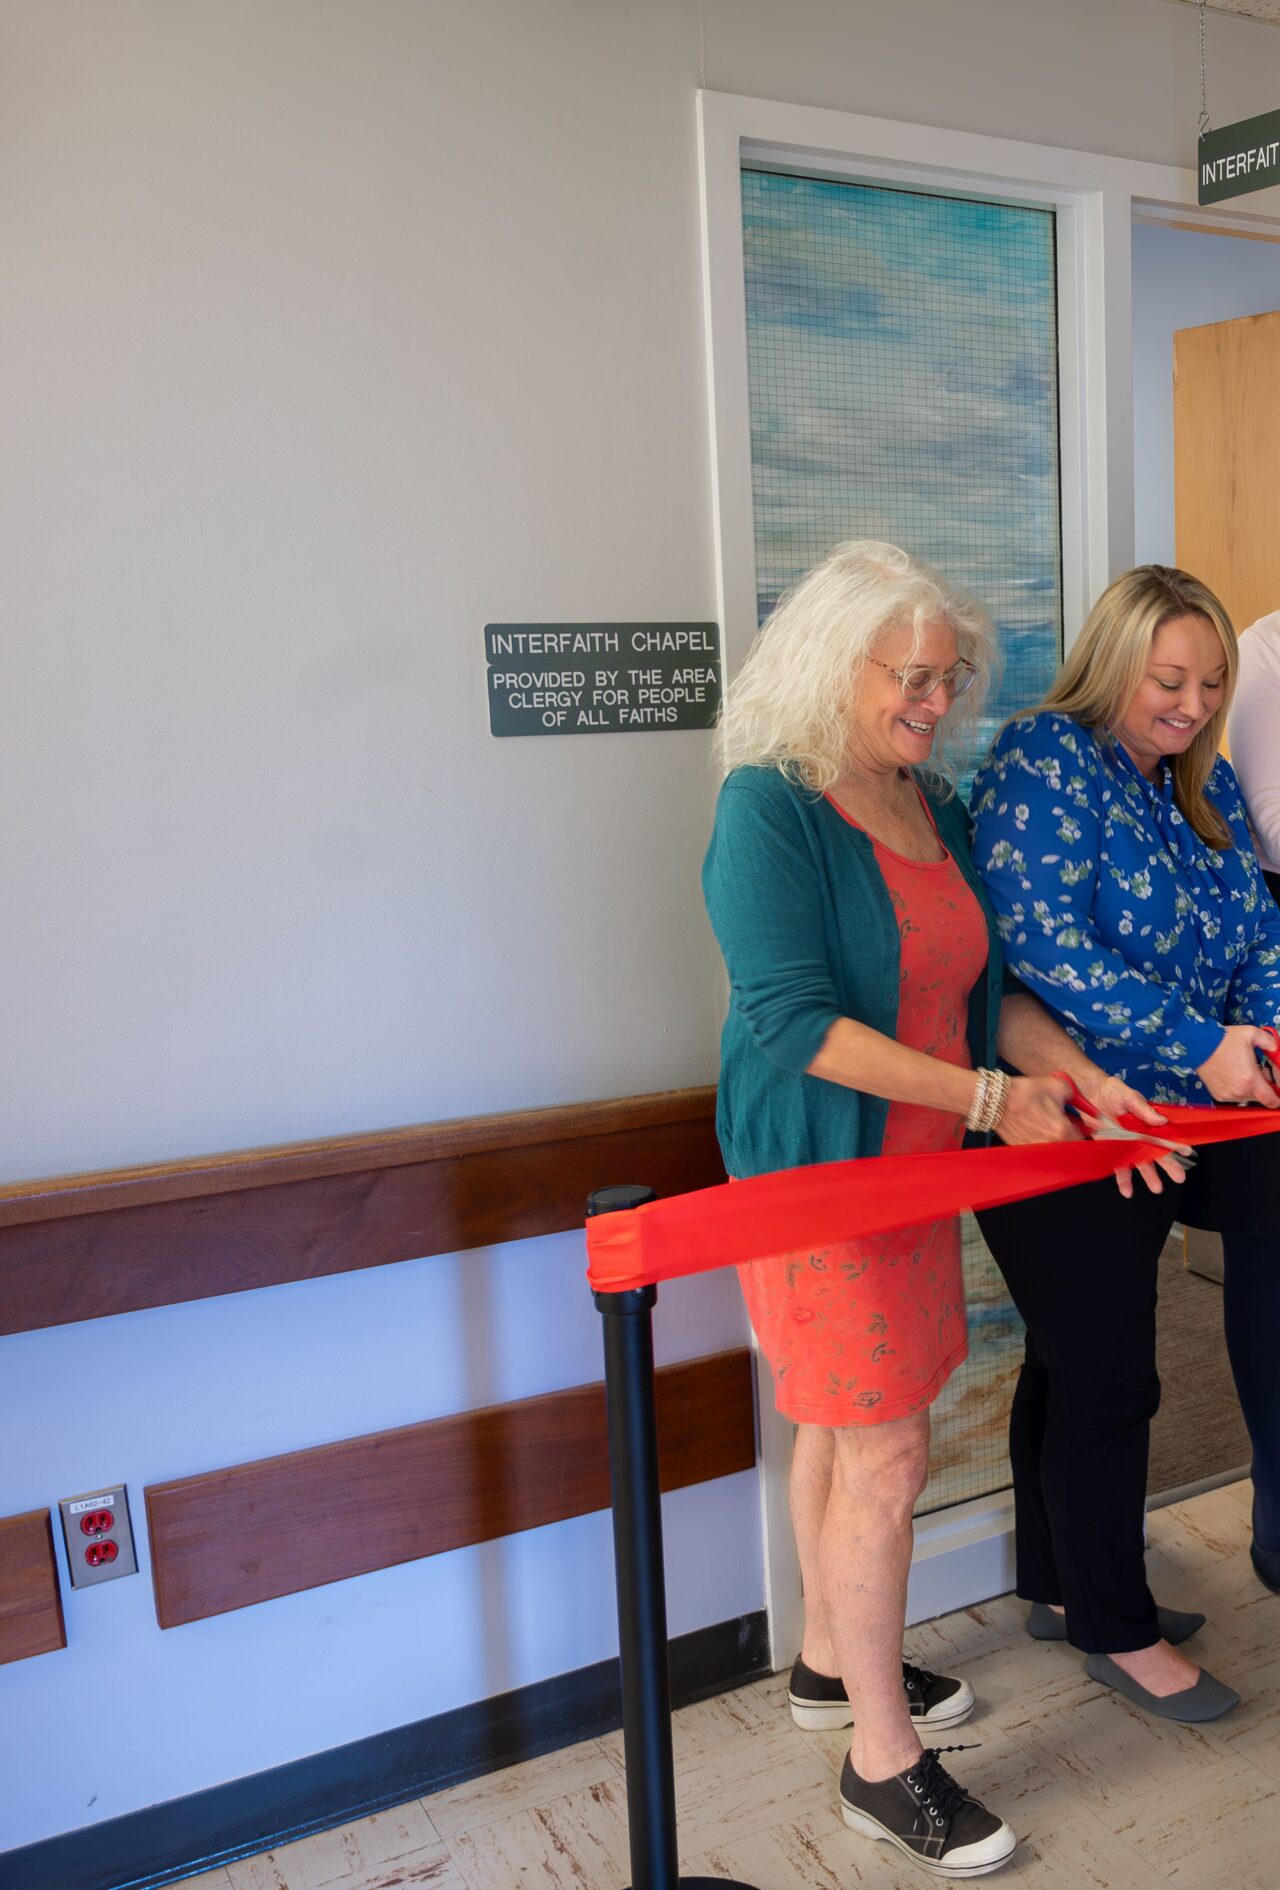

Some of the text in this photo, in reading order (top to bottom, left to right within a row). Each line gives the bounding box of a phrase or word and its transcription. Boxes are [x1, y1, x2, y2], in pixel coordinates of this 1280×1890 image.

[491, 631, 714, 654] INTERFAITH CHAPEL
[493, 668, 717, 689] PROVIDED BY THE AREA
[508, 687, 706, 709] CLERGY FOR PEOPLE
[542, 707, 678, 727] OF ALL FAITHS
